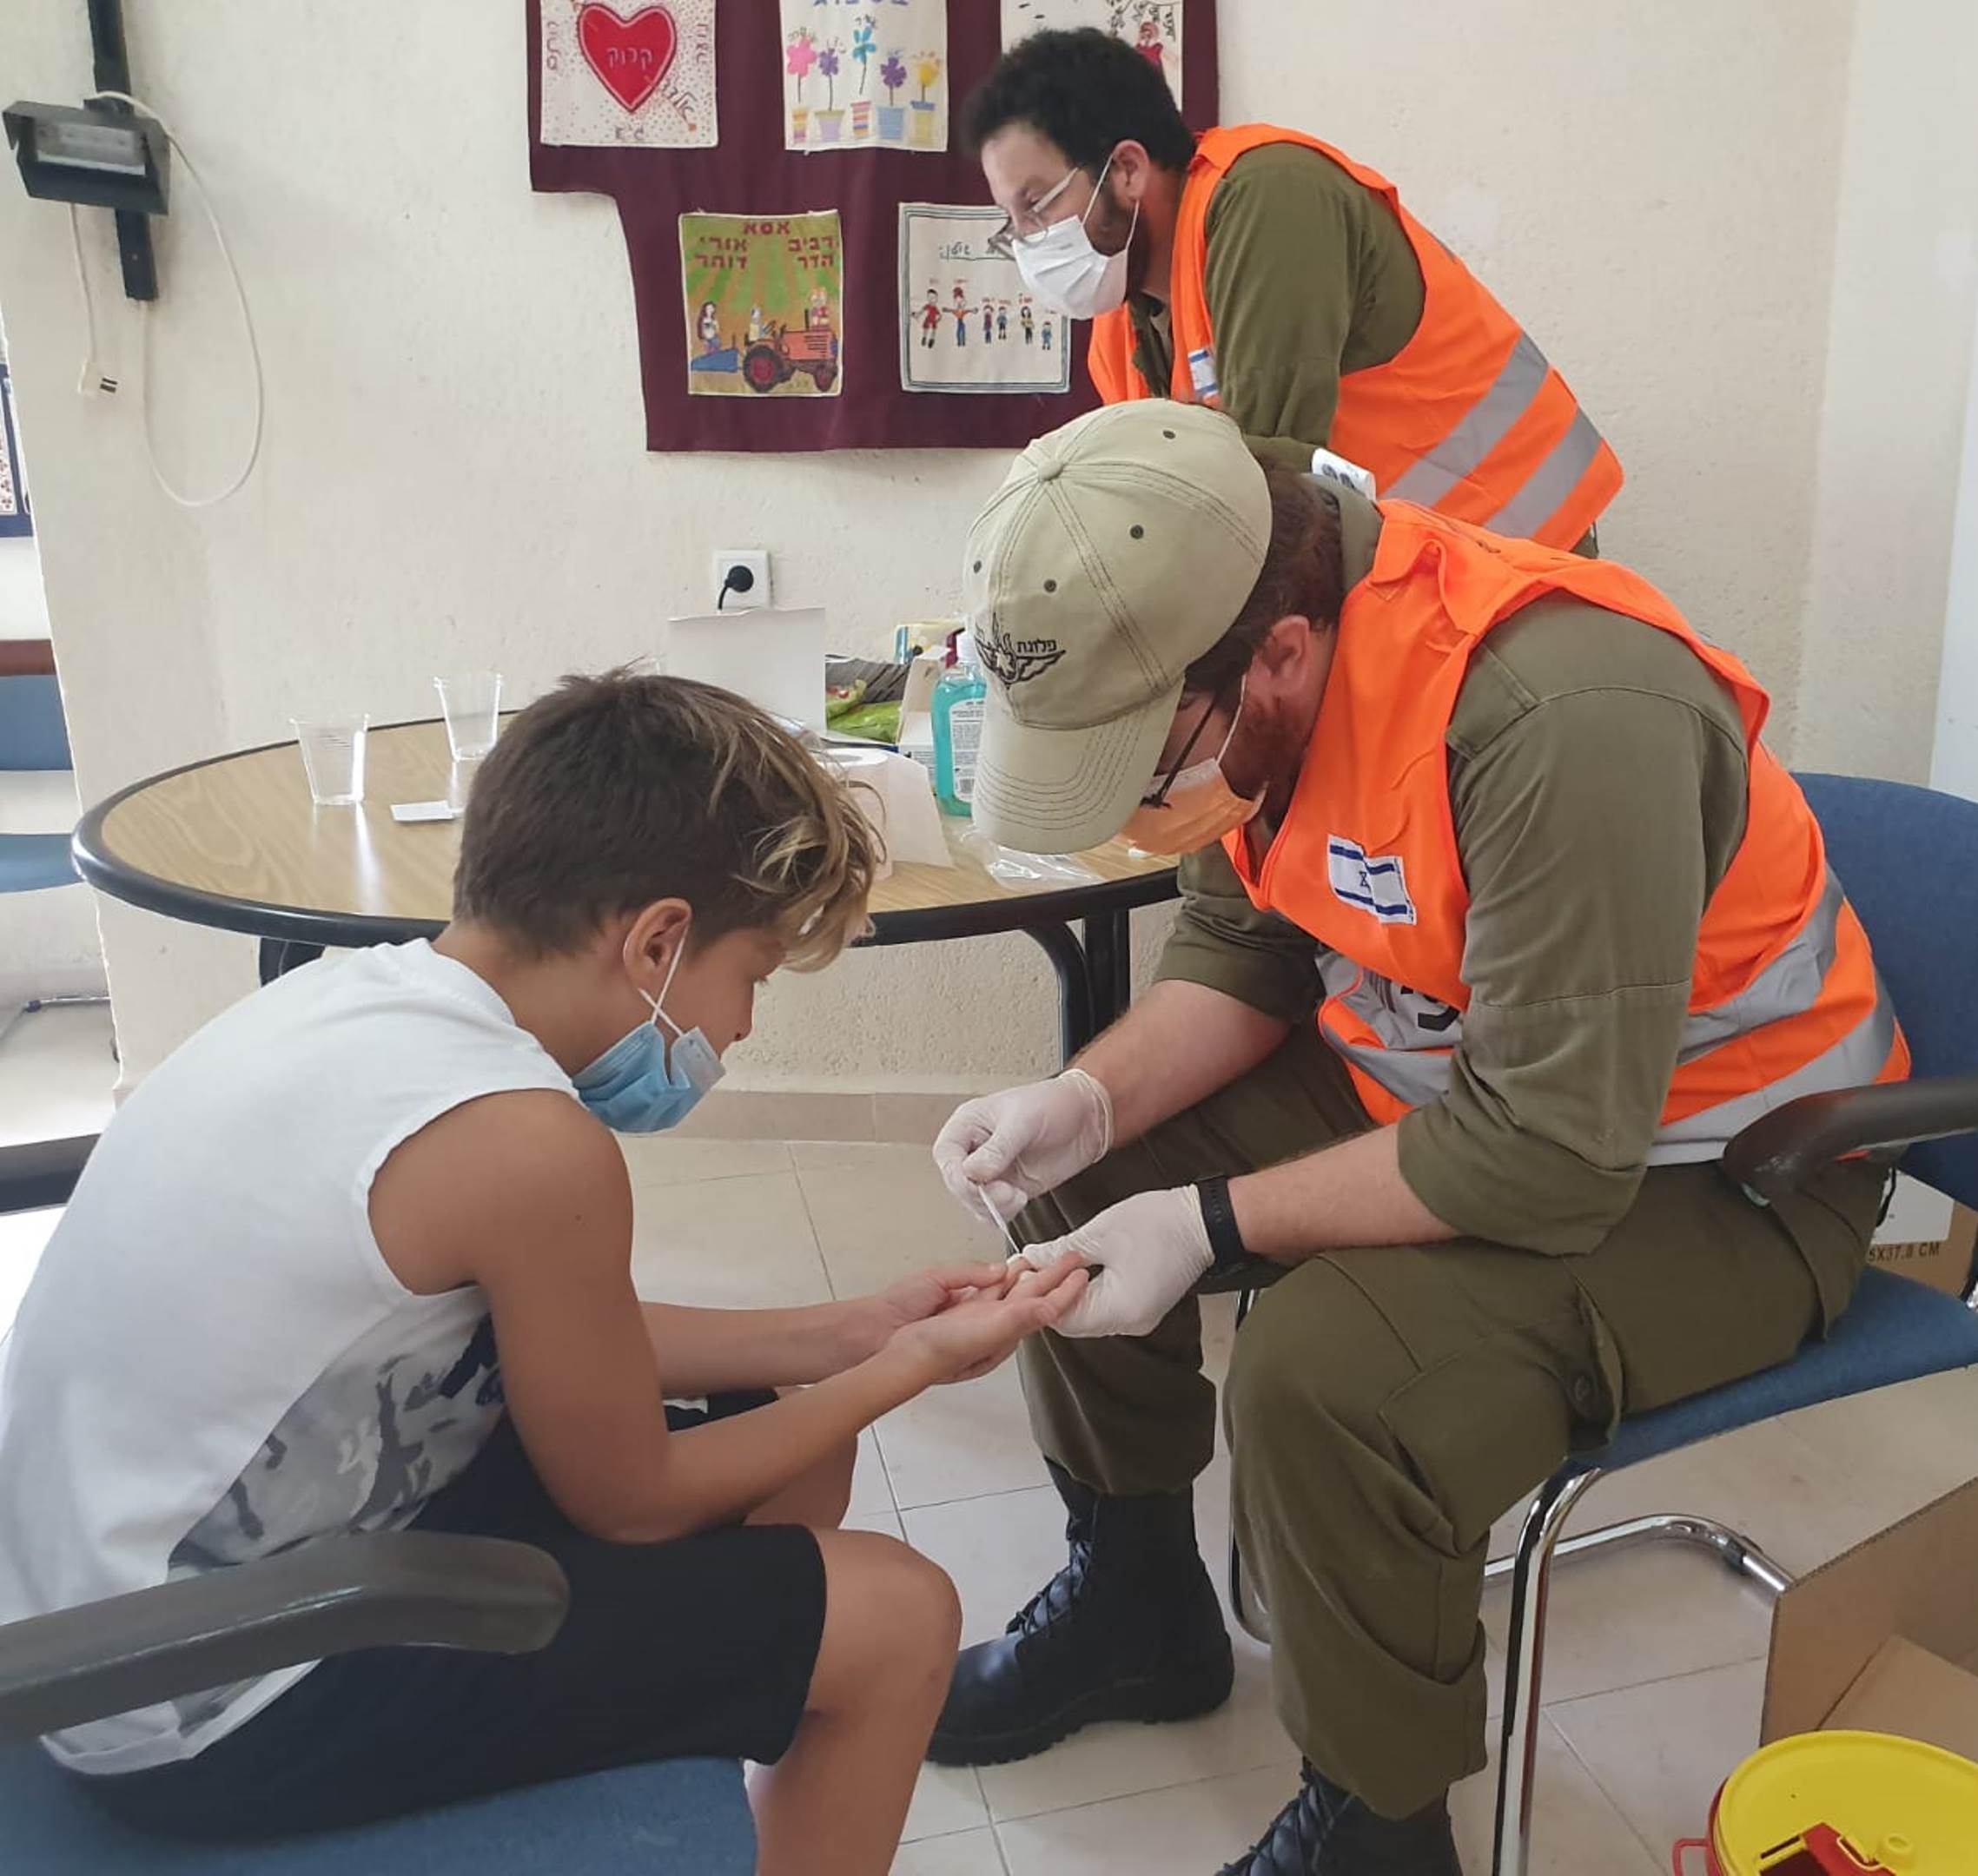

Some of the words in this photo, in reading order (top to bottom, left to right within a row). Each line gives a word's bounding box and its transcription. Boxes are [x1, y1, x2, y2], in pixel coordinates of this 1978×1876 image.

[744, 221, 791, 234] אסא
[700, 236, 747, 251] אורי
[1918, 1241, 1940, 1257] CM
